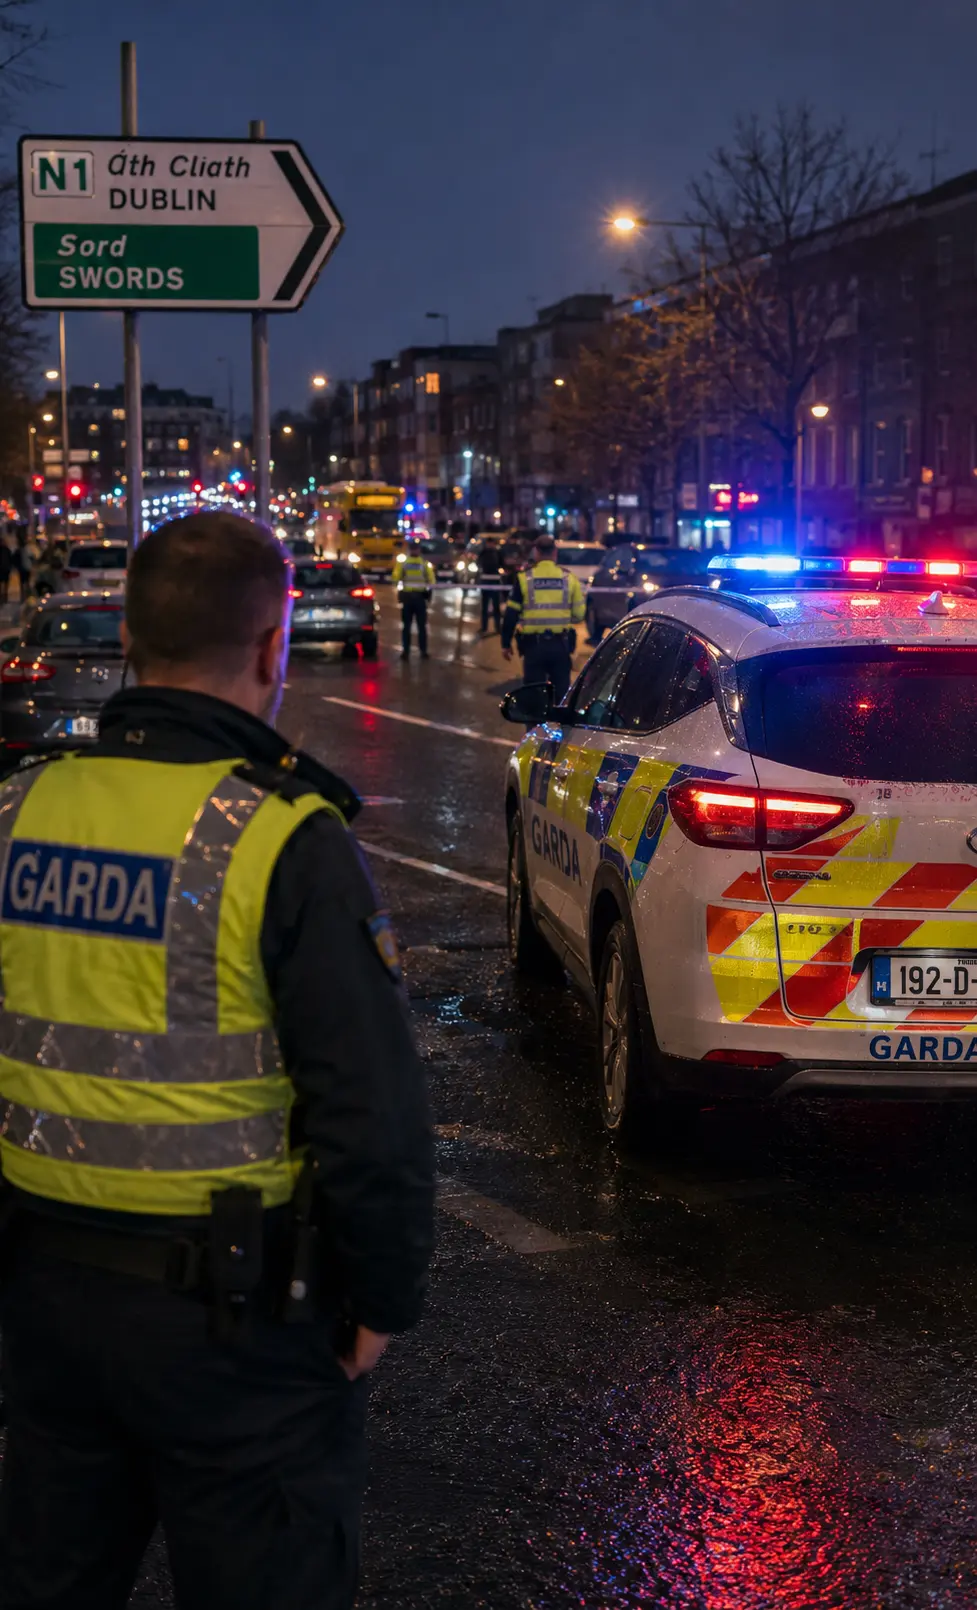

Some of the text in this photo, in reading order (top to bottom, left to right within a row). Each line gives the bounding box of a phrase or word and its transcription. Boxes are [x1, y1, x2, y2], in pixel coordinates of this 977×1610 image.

[38, 157, 88, 192] N1
[168, 154, 251, 179] Cliath
[109, 188, 217, 212] DUBLIN
[57, 233, 128, 258] Sord
[58, 266, 185, 291] SWORDS
[531, 814, 583, 888] GARDA
[9, 852, 157, 929] GARDA
[869, 1034, 977, 1061] GARDA
